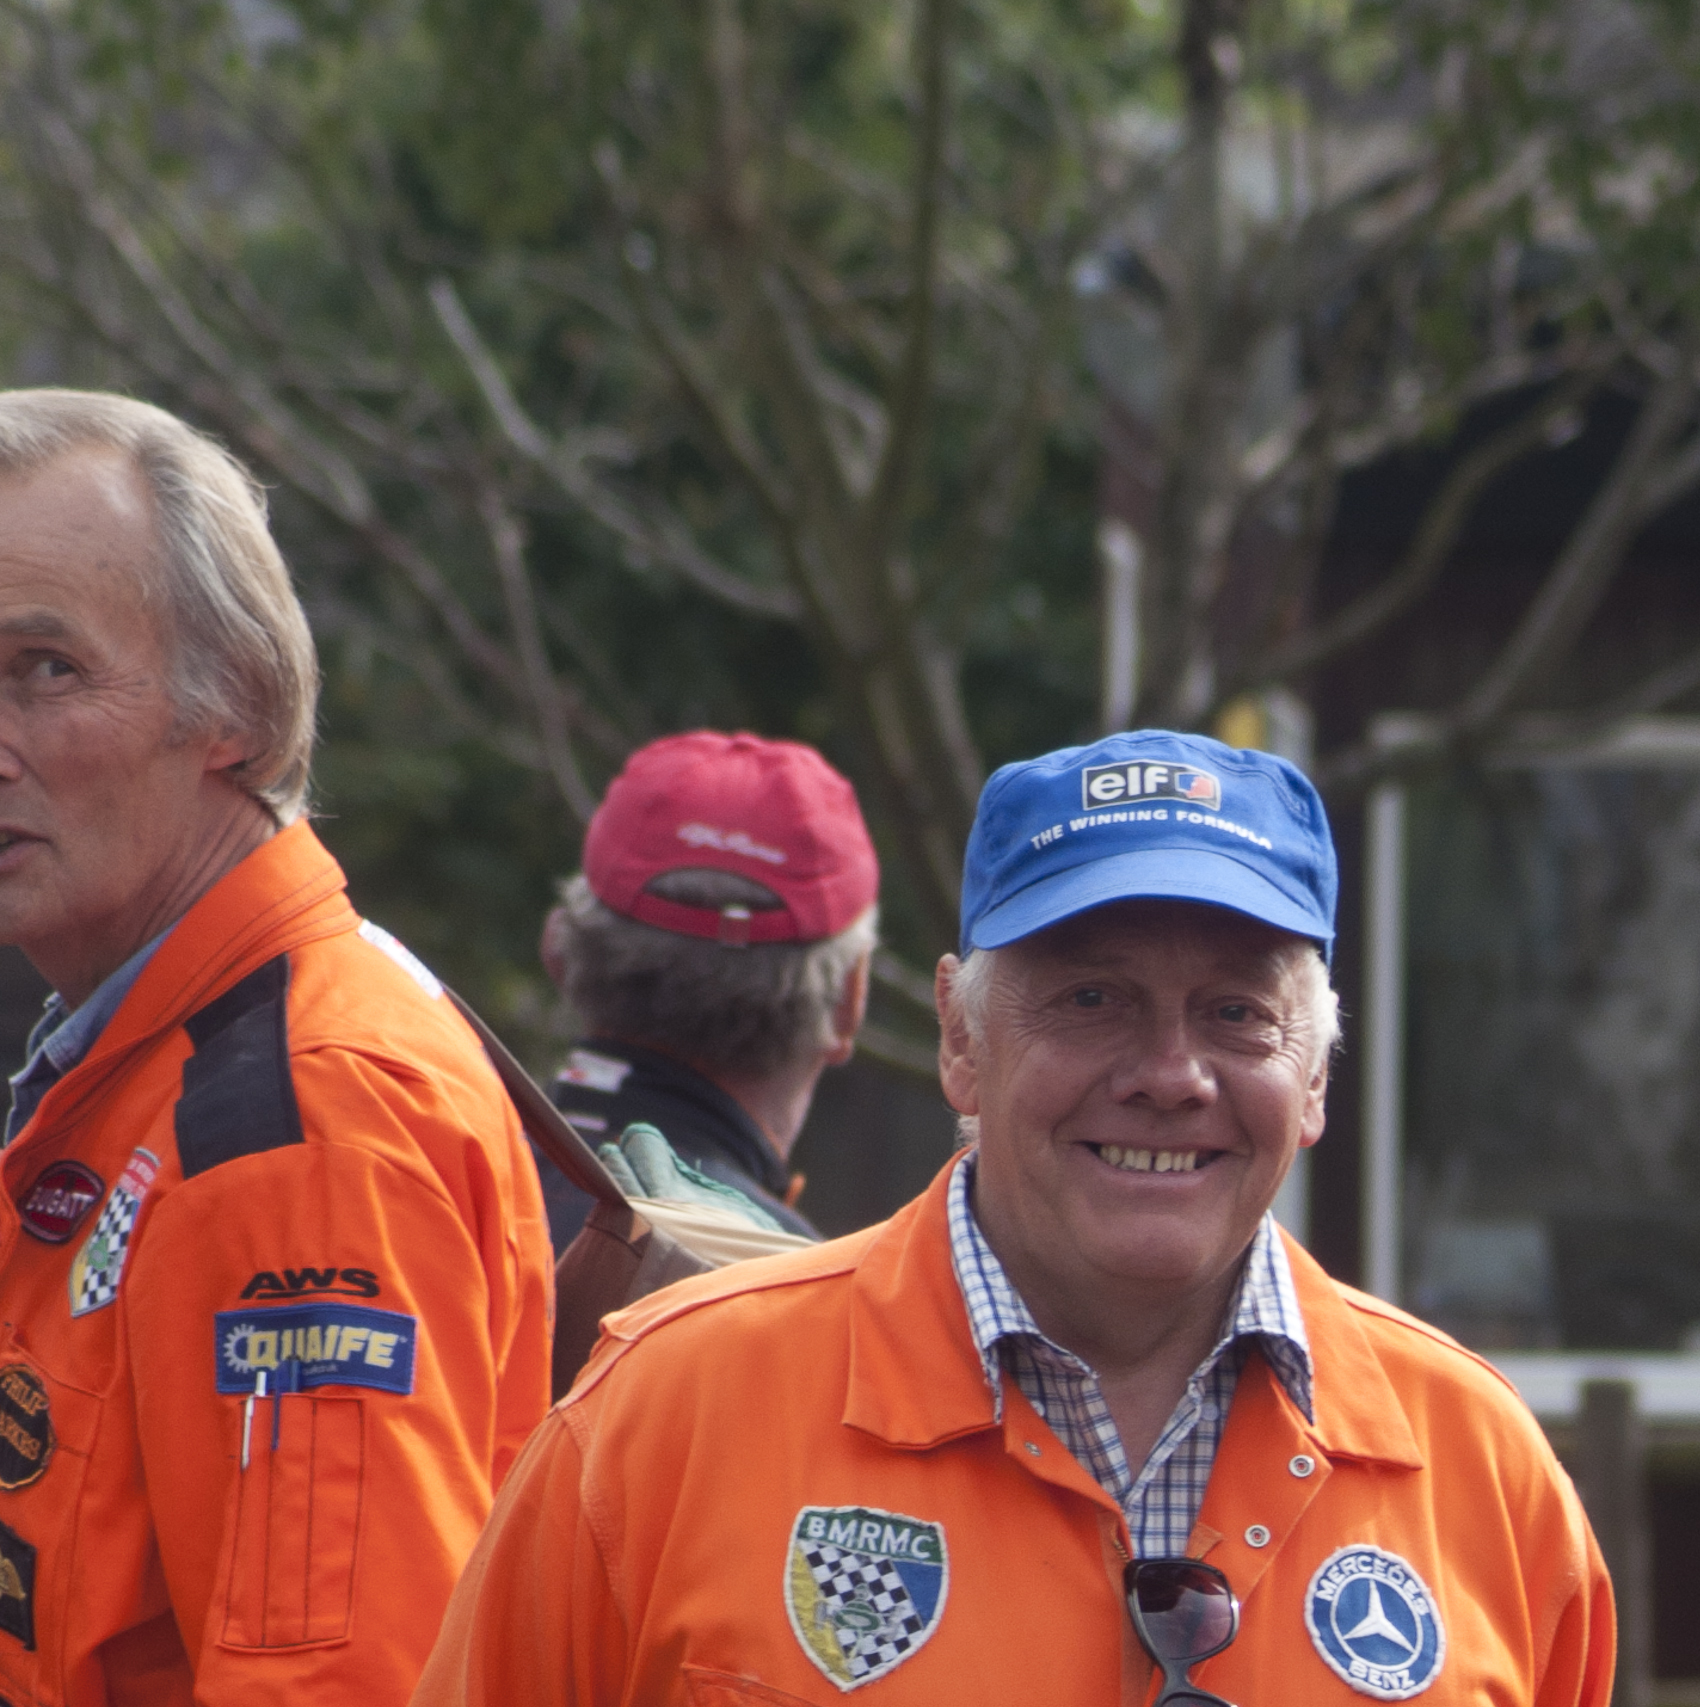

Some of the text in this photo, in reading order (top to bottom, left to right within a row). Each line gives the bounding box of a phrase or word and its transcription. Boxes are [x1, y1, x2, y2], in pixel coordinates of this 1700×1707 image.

[1089, 767, 1168, 800] elf
[1030, 809, 1273, 850] THE WINNING FORMULA
[240, 1267, 380, 1299] AWS
[246, 1324, 399, 1370] QUAIFE
[807, 1515, 934, 1560] BMRMC
[1315, 1554, 1431, 1617] MERCEDES
[1349, 1659, 1416, 1690] BENZ
